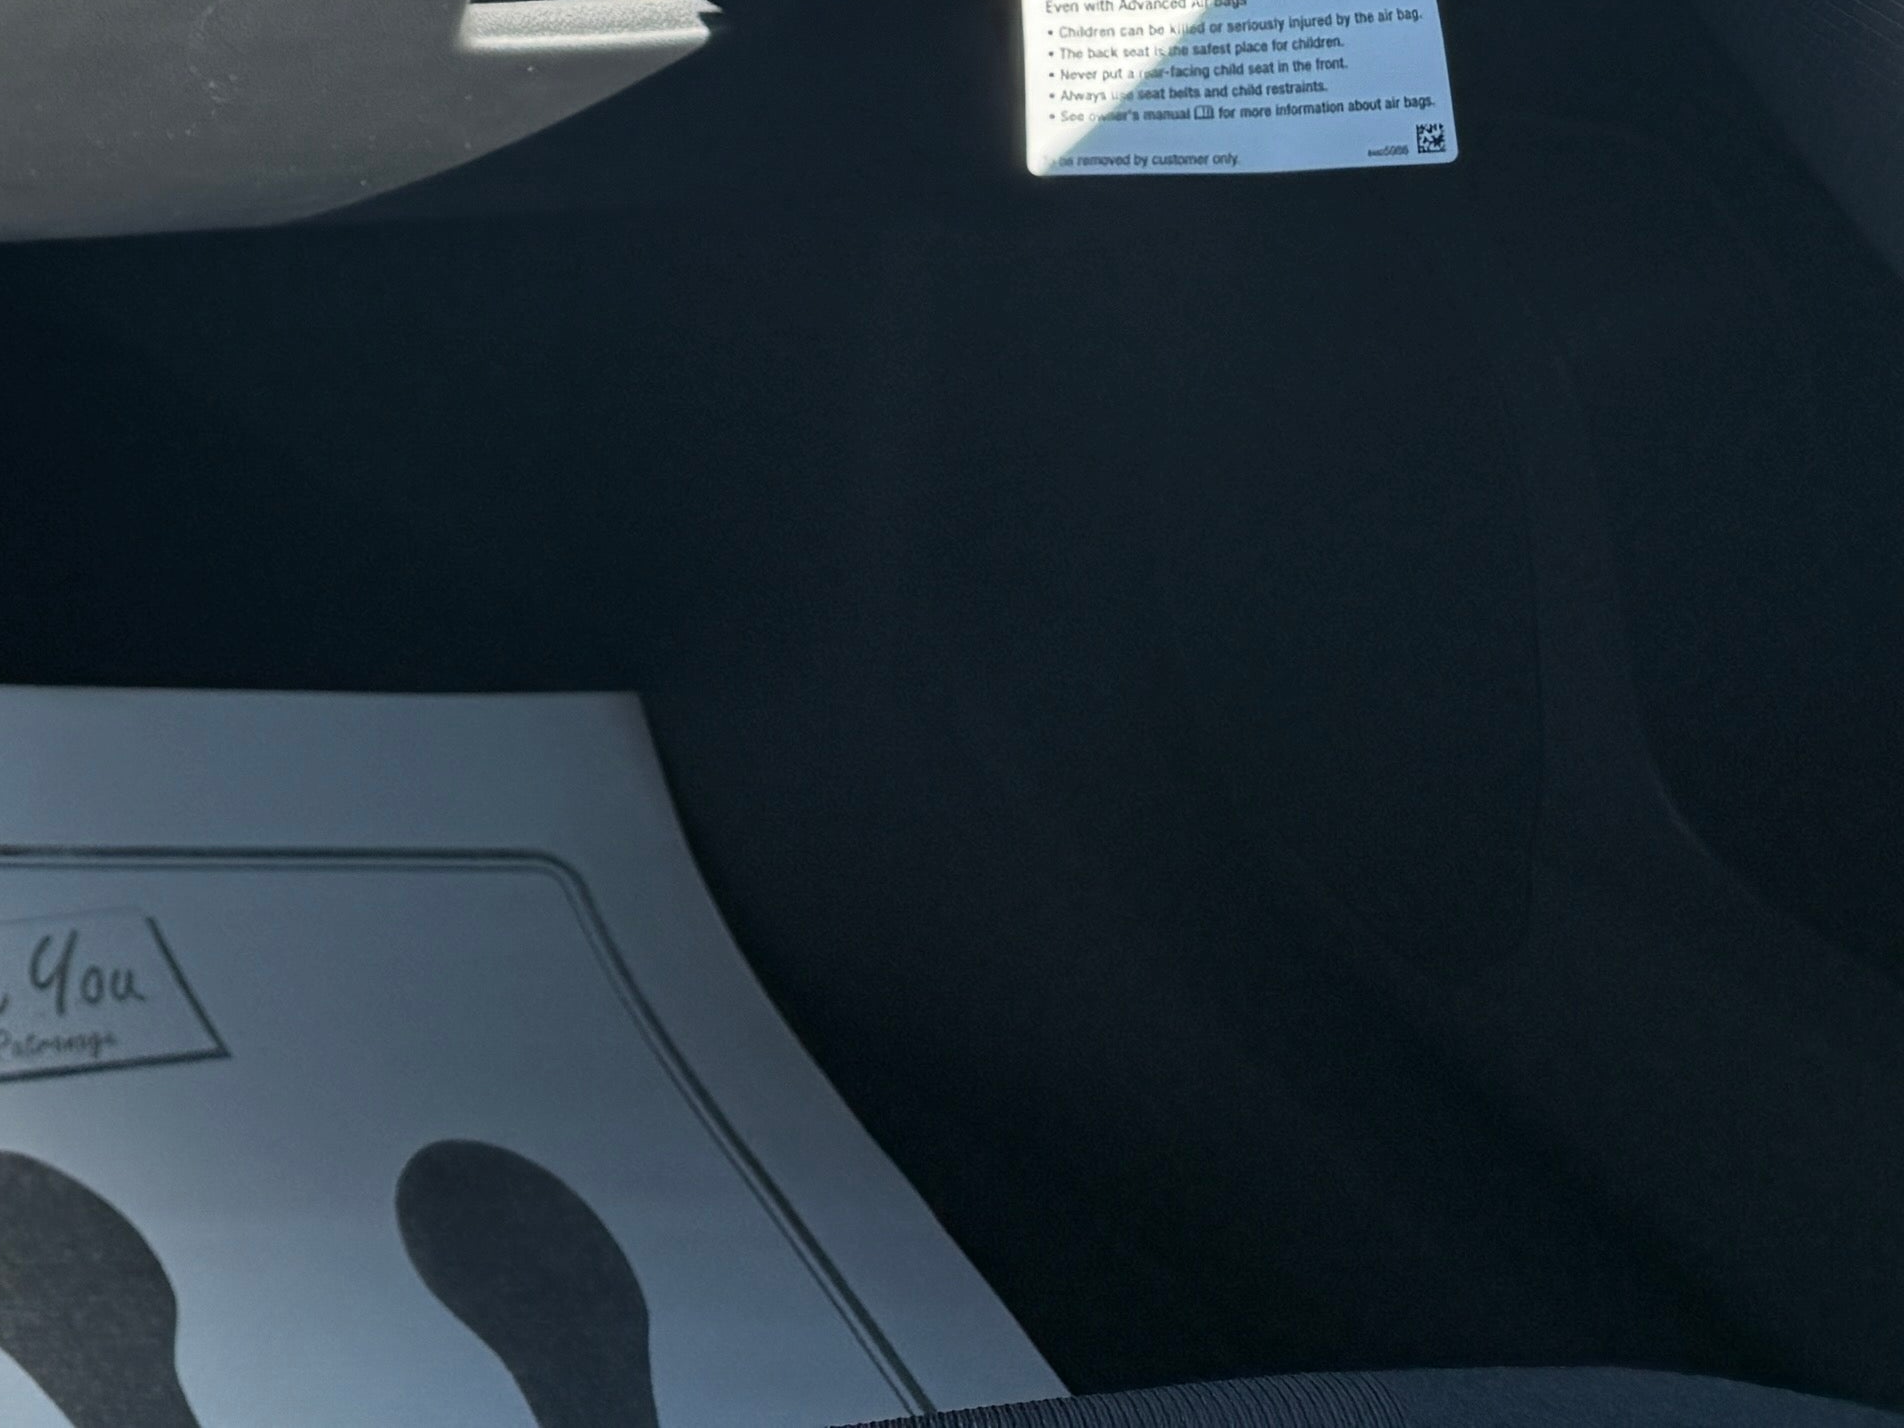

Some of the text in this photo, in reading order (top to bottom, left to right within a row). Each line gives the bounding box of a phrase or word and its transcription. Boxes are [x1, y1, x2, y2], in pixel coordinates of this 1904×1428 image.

[1044, 0, 1080, 14] Even
[1058, 22, 1116, 39] Children
[1119, 24, 1144, 37] can
[1148, 21, 1166, 37] be
[1208, 20, 1224, 34] or
[1226, 14, 1285, 34] seriously
[1288, 11, 1333, 29] injured
[1336, 9, 1352, 27] by
[1354, 8, 1375, 25] the
[1377, 6, 1394, 24] air
[1395, 5, 1423, 23] bag.
[1059, 45, 1083, 60] The
[1087, 43, 1119, 60] back
[1192, 39, 1232, 56] safest
[1234, 38, 1269, 58] place
[1272, 36, 1290, 52] for
[1291, 33, 1345, 51] children.
[1059, 66, 1098, 82] Never
[1102, 65, 1123, 84] put
[1213, 59, 1245, 78] child
[1247, 59, 1276, 76] seat
[1277, 57, 1289, 74] in
[1291, 56, 1313, 73] the
[1315, 55, 1349, 72] front.
[1059, 78, 1329, 105] Always seat belts and child restraints.
[1059, 108, 1085, 123] See
[1143, 105, 1191, 121] manual
[1218, 103, 1237, 119] for
[1239, 104, 1272, 118] more
[1274, 99, 1344, 117] information
[1346, 96, 1383, 113] about
[1385, 94, 1400, 111] air
[1402, 92, 1436, 112] bags.
[1076, 151, 1131, 167] removed
[1133, 150, 1149, 169] by
[1151, 150, 1210, 167] customer
[28, 929, 146, 1017] You
